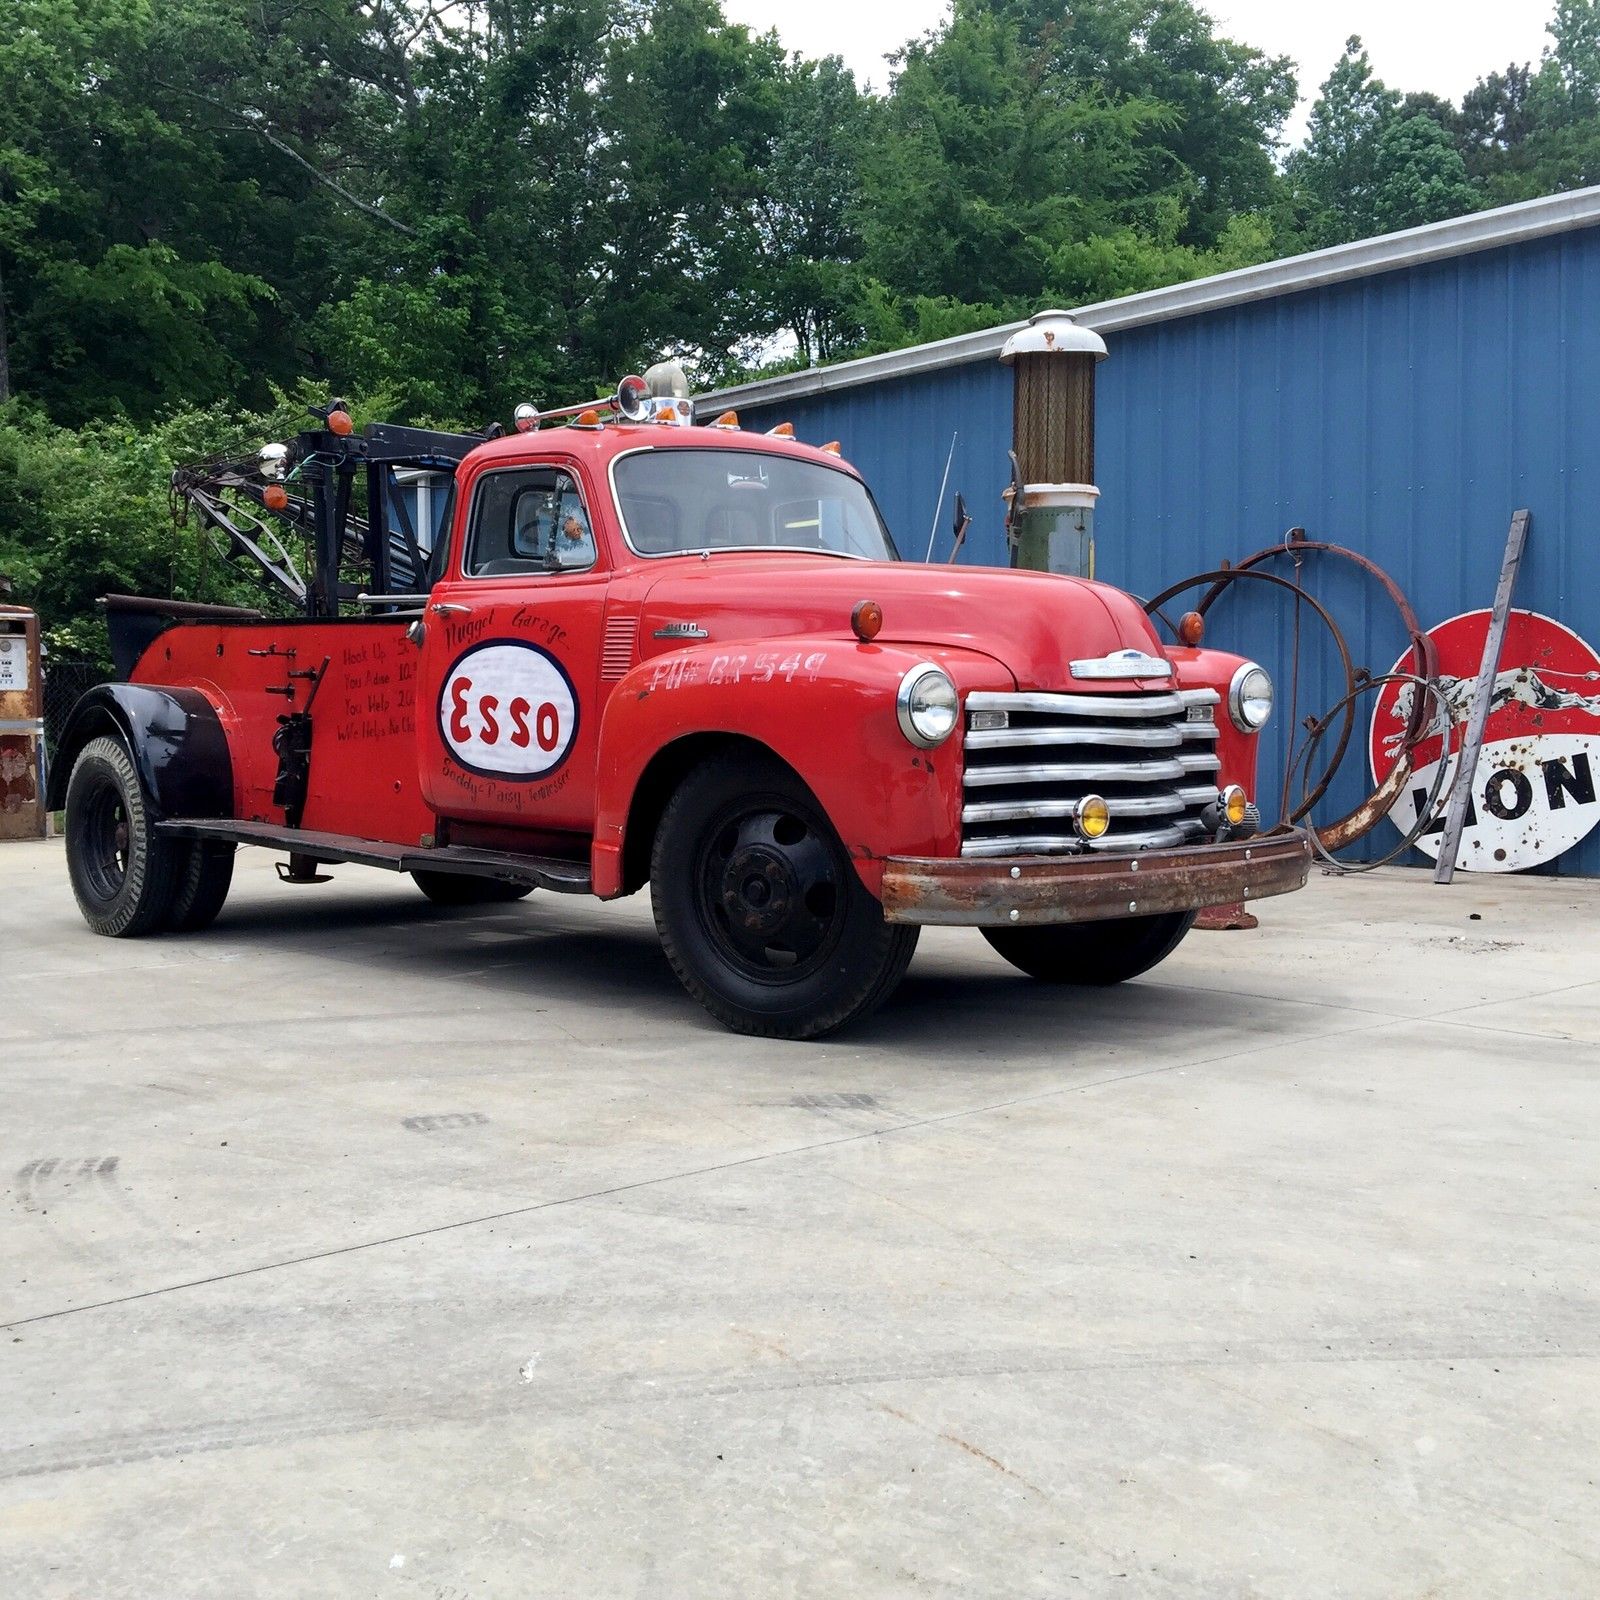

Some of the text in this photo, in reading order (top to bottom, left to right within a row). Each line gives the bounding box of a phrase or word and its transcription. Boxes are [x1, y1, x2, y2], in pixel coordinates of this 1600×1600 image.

[511, 607, 569, 648] Garage
[372, 641, 387, 664] Up
[344, 697, 362, 716] You
[367, 693, 390, 713] Help
